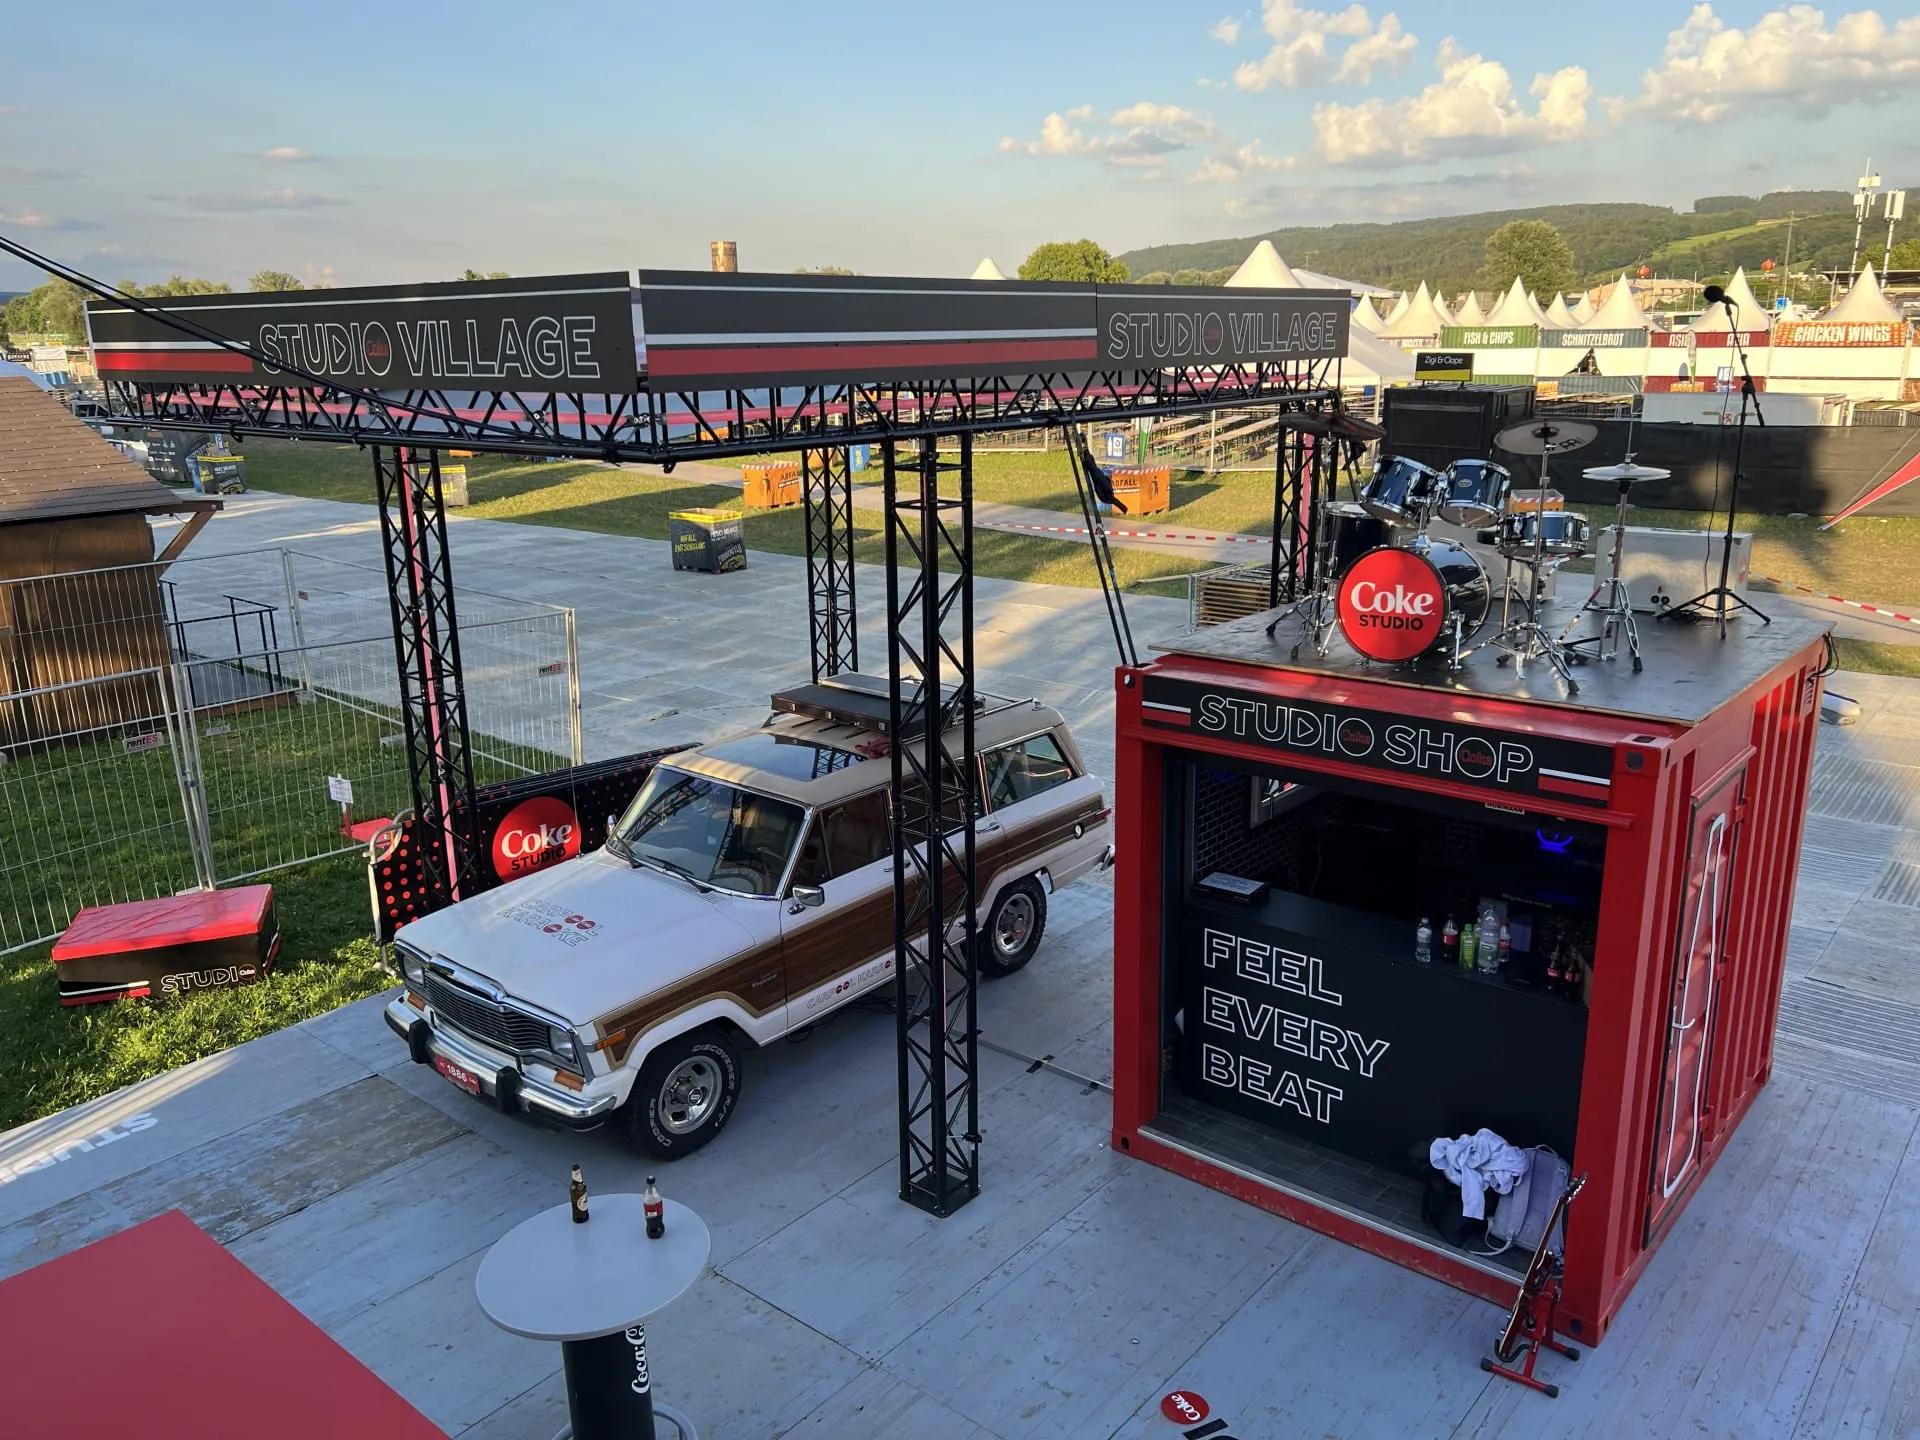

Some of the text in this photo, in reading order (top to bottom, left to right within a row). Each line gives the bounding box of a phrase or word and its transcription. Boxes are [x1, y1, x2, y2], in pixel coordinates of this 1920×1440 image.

[259, 315, 601, 379] STUDIO VILLAGE
[1108, 312, 1338, 360] STUDIO VILLAGE
[1464, 331, 1514, 345] FISH & CHIPS
[1562, 333, 1624, 346] SCHNITZELBROT
[1669, 333, 1689, 347] ASI
[1794, 325, 1890, 342] CHICKEN WINGS
[1424, 356, 1437, 366] Zigi
[1351, 581, 1434, 616] Coke
[1359, 614, 1424, 631] STUDIO
[126, 733, 158, 750] rentES
[1199, 694, 1534, 783] STUDIO SHOP
[501, 823, 573, 858] Coke
[511, 845, 567, 871] STUDIO
[1204, 928, 1343, 1007] FEEL
[1203, 986, 1391, 1078] EVERY
[447, 1064, 468, 1082] 1886
[1203, 1043, 1343, 1124] BEAT
[1171, 1393, 1201, 1421] Coke
